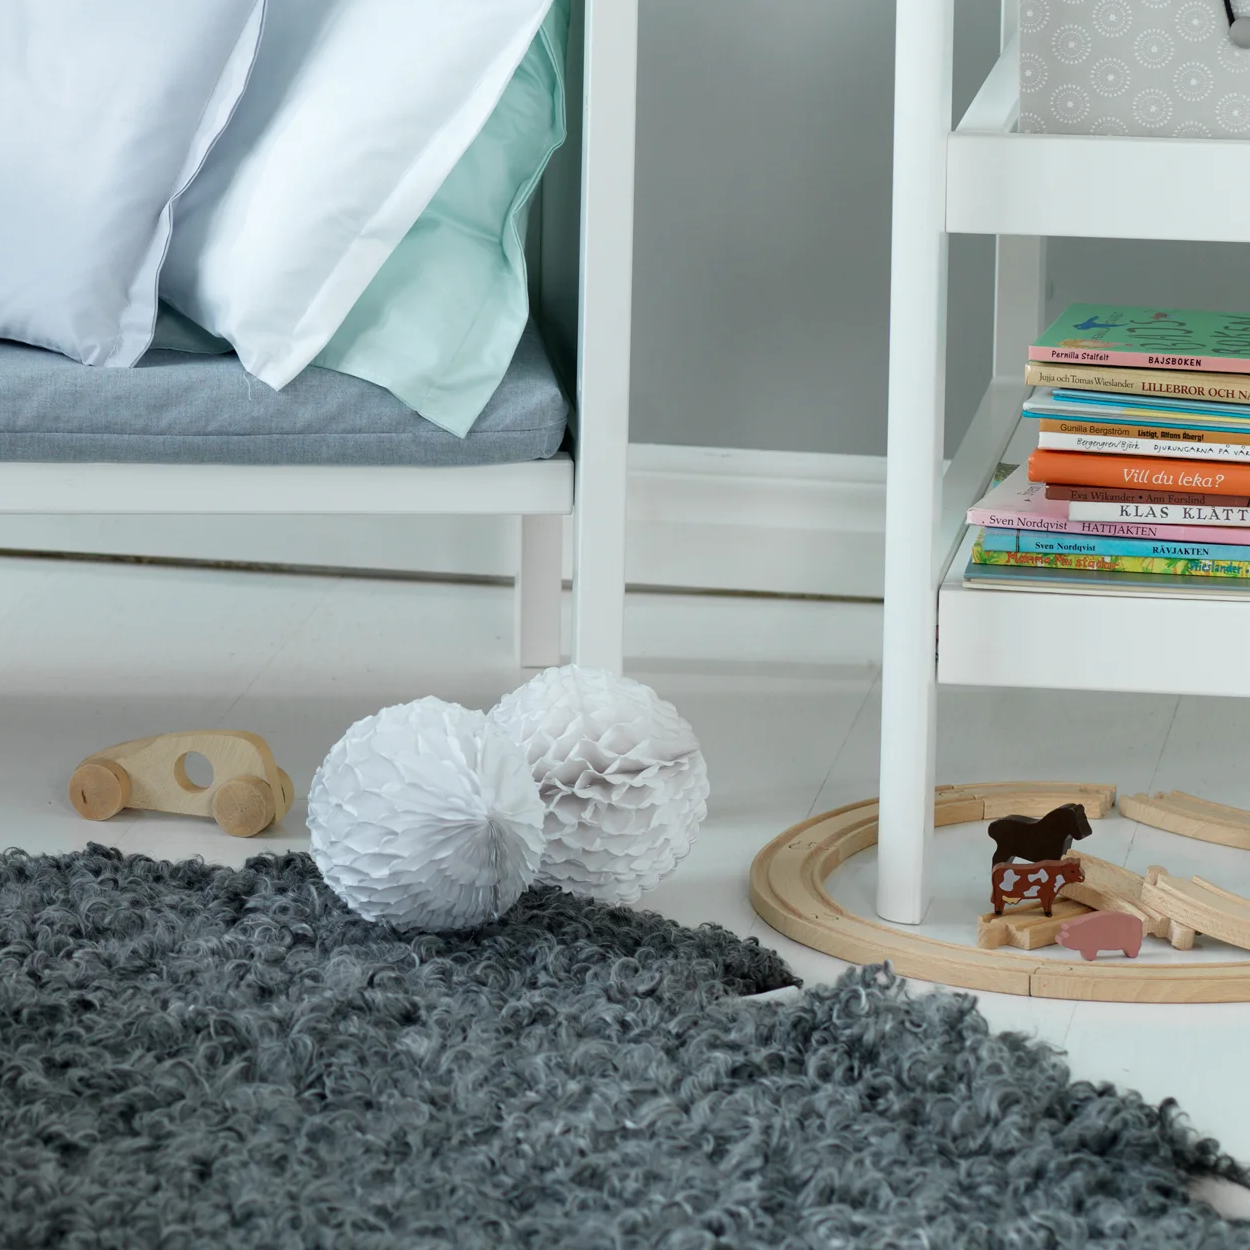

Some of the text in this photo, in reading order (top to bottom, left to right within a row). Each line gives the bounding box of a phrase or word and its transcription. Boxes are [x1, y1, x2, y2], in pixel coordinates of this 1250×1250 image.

[1051, 350, 1110, 361] Pernilla Stalfelt
[1148, 356, 1202, 367] BAJSBOKEN
[1038, 372, 1135, 389] Jujja och Tomas Wieslander
[1141, 381, 1205, 396] LILLEBROR
[1208, 387, 1235, 399] OCH
[1060, 423, 1130, 437] Gunilla Bergström
[1138, 429, 1204, 442] Listigt, Alfons Åberg!
[1154, 444, 1214, 454] DJURUNGARNA
[1218, 444, 1230, 455] PÅ
[1122, 468, 1225, 488] Vill du leka?
[1070, 490, 1206, 505] Eva Wikander Ann Forslind
[1119, 505, 1250, 522] KLAS KLÄTT
[989, 515, 1068, 531] Sven Nordqvist
[1081, 522, 1158, 537] HATTJAKTEN
[1035, 541, 1096, 553] Sven Nordqvist
[1053, 554, 1073, 567] Mu
